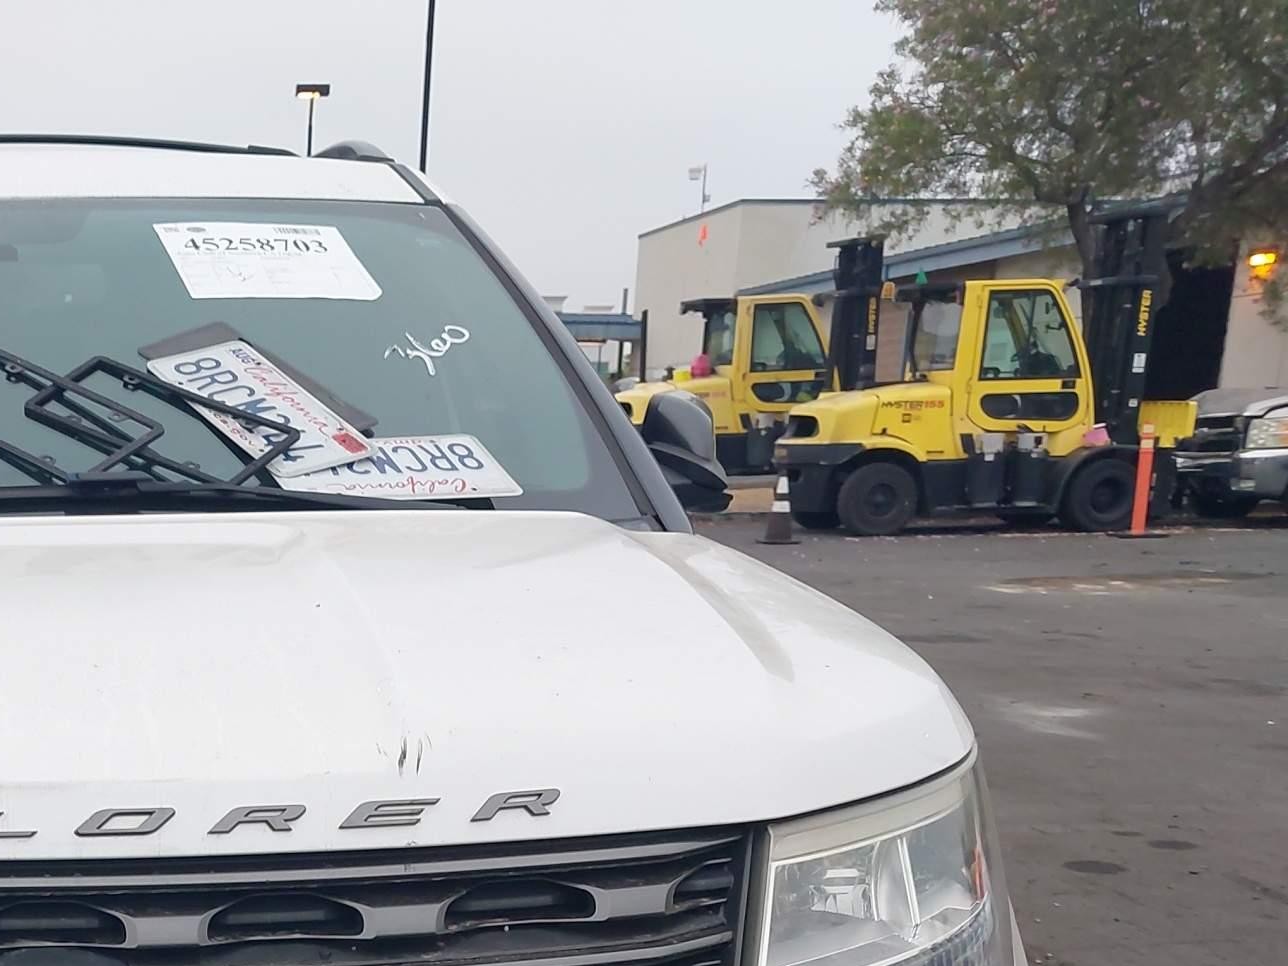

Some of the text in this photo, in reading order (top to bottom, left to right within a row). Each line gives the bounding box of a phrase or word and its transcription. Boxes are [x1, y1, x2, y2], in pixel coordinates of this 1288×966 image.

[184, 237, 328, 253] 45258703
[1136, 289, 1153, 336] HYSTER
[328, 475, 467, 494] California
